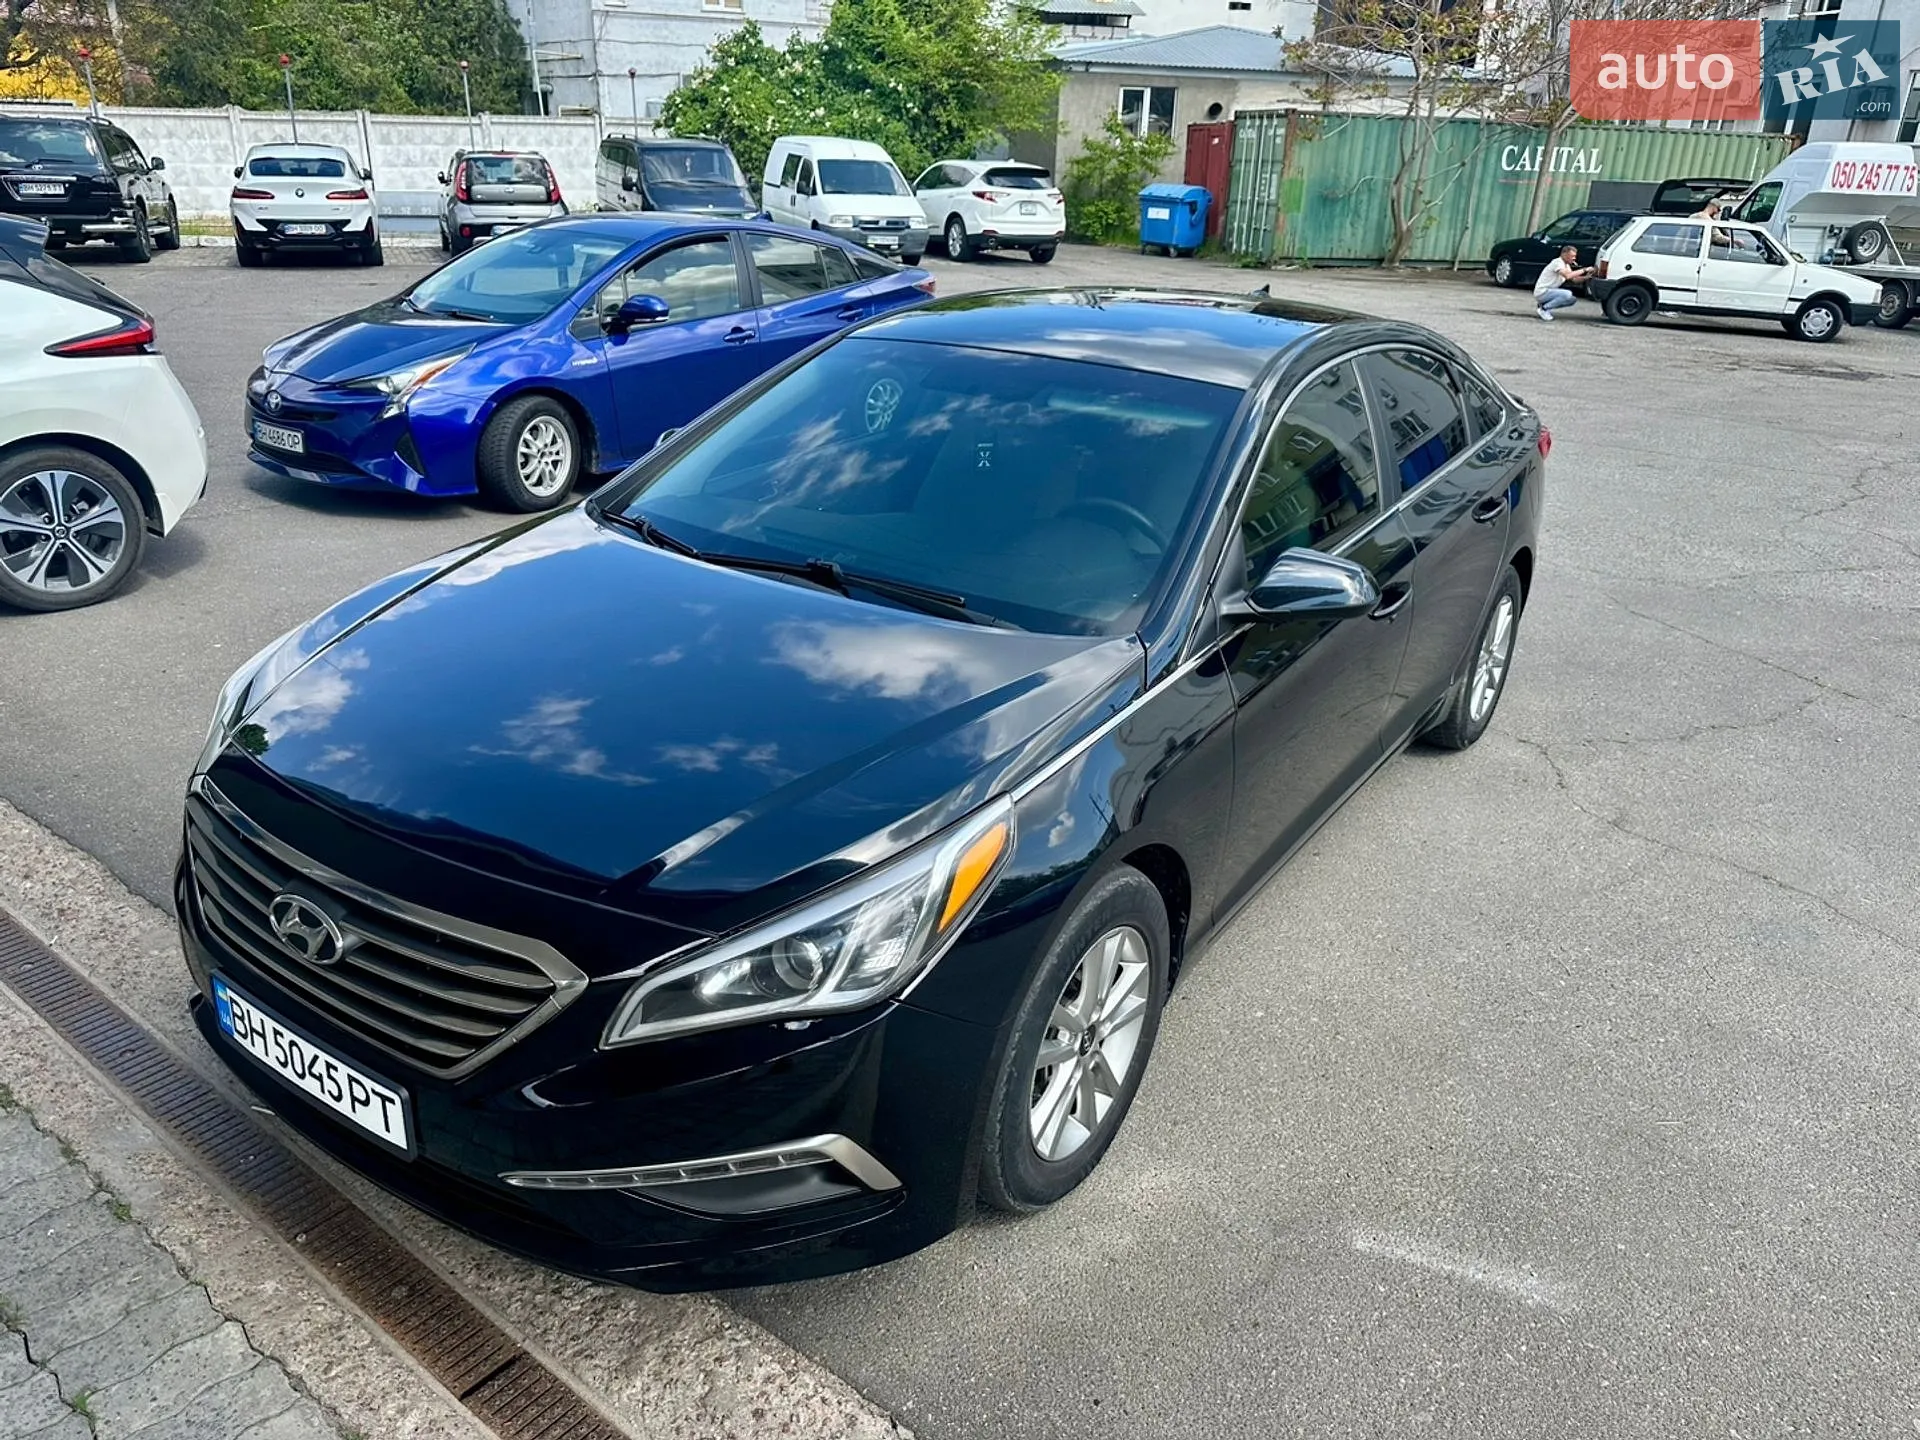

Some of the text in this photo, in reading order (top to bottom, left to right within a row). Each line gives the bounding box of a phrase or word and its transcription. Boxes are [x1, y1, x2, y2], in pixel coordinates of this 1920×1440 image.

[1831, 161, 1916, 192] 050 245 77 75
[229, 995, 396, 1134] BH 5045 PT
